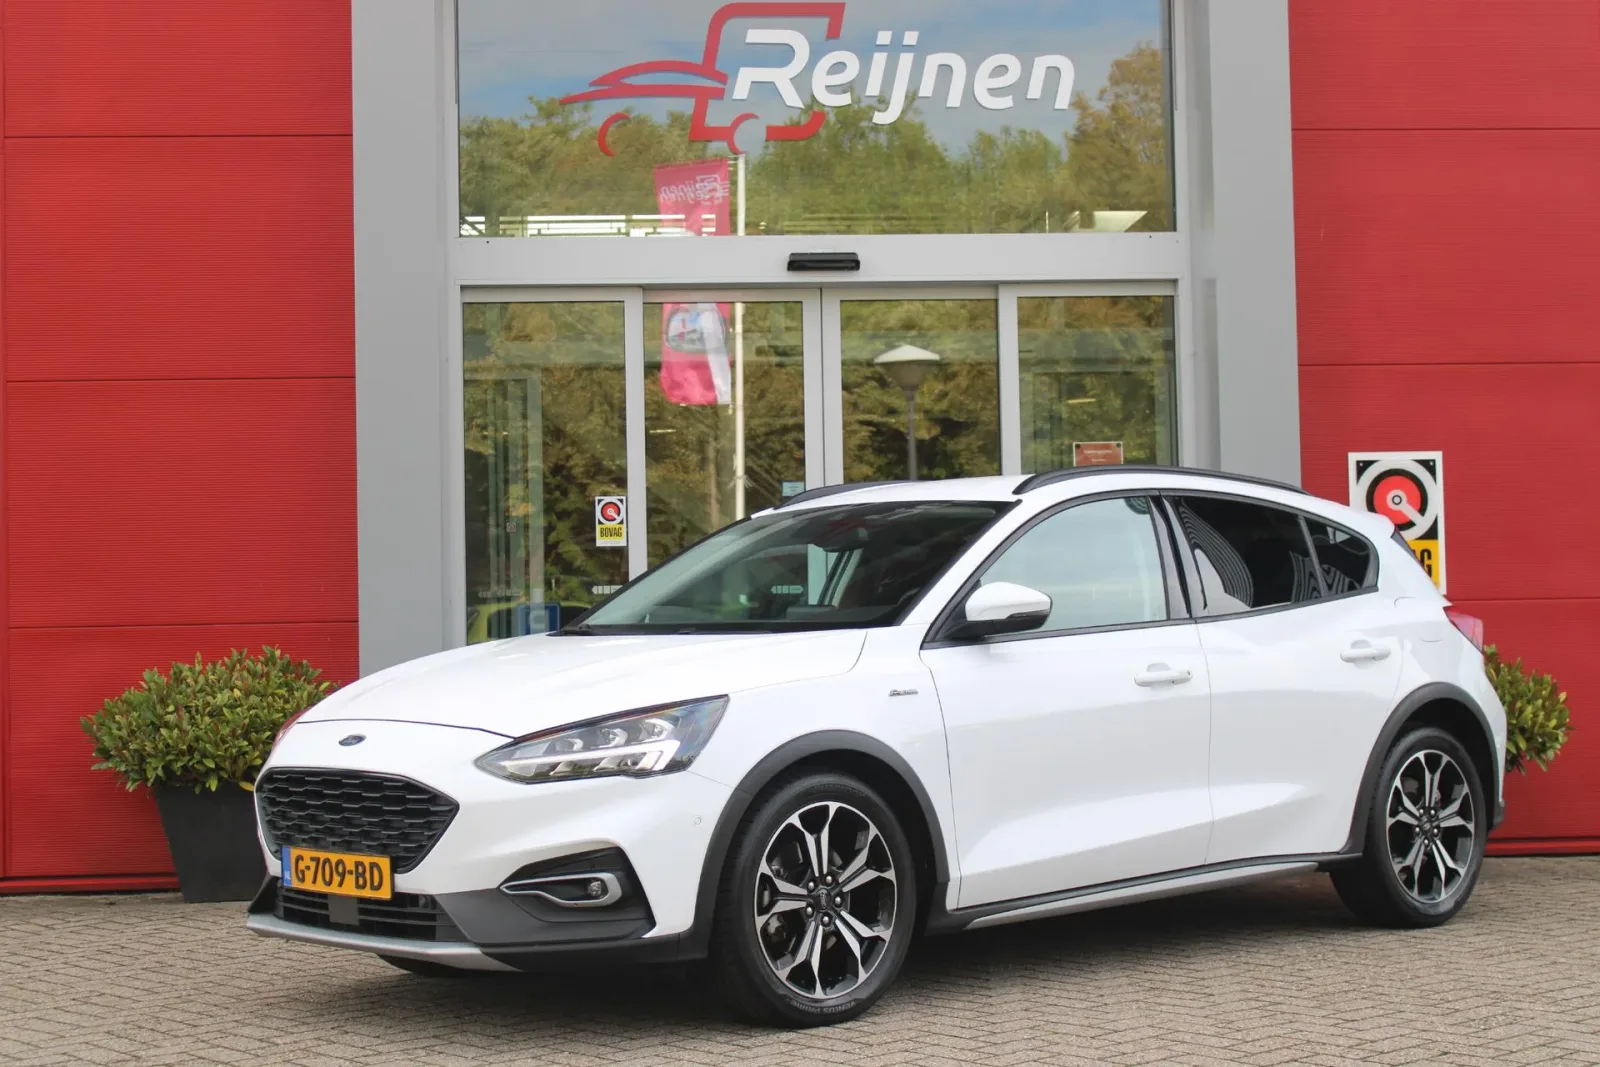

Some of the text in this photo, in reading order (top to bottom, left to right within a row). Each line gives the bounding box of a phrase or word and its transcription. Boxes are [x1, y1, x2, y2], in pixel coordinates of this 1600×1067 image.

[732, 29, 1075, 125] Reijnen
[600, 527, 622, 537] BOVAG
[294, 854, 383, 891] G-709-BD
